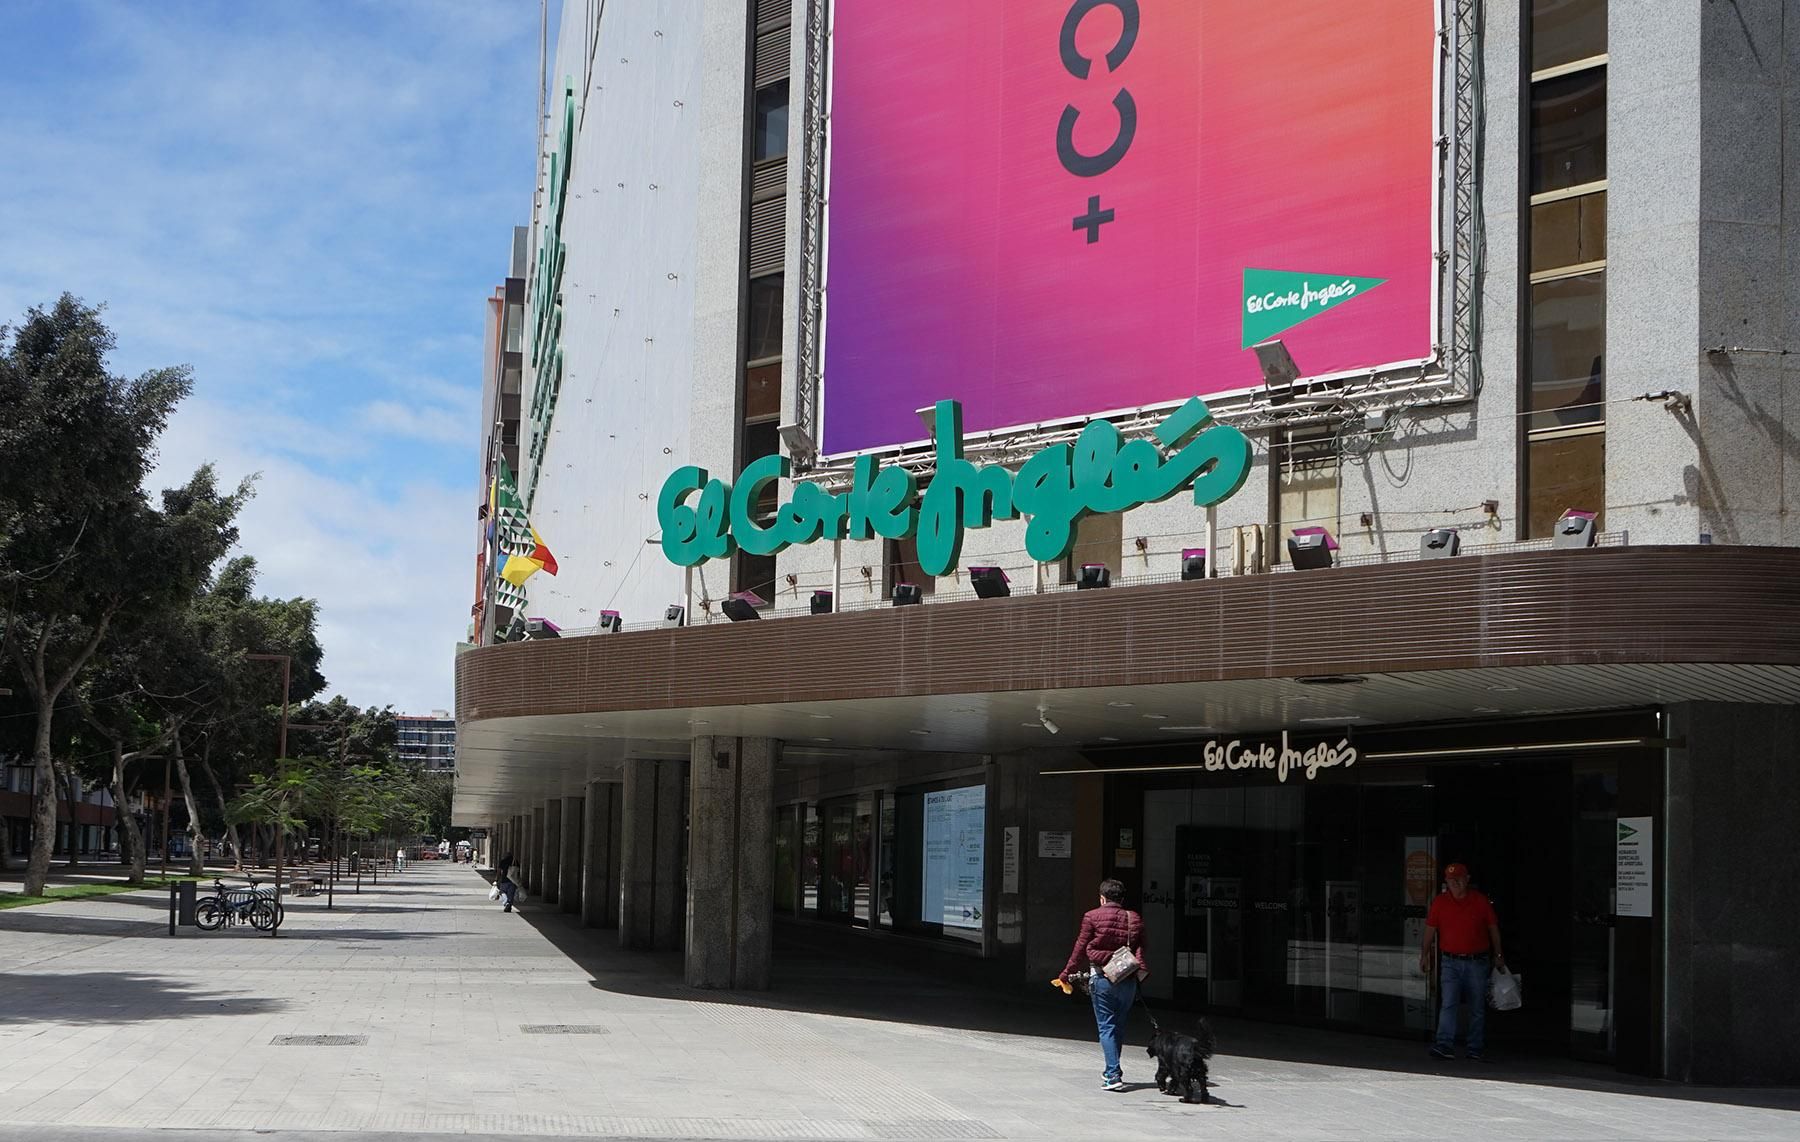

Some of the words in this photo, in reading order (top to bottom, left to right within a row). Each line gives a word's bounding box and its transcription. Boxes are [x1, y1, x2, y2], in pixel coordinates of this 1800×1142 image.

[1247, 295, 1263, 313] El
[1263, 291, 1300, 310] Corte
[1301, 279, 1356, 310] Inglés
[658, 465, 737, 567] El
[730, 455, 919, 556] Corte
[916, 395, 1253, 576] Inglés
[1204, 740, 1225, 771] El
[1225, 740, 1276, 770] Corte
[1278, 730, 1357, 783] Inglés
[1254, 901, 1289, 911] WELCOME
